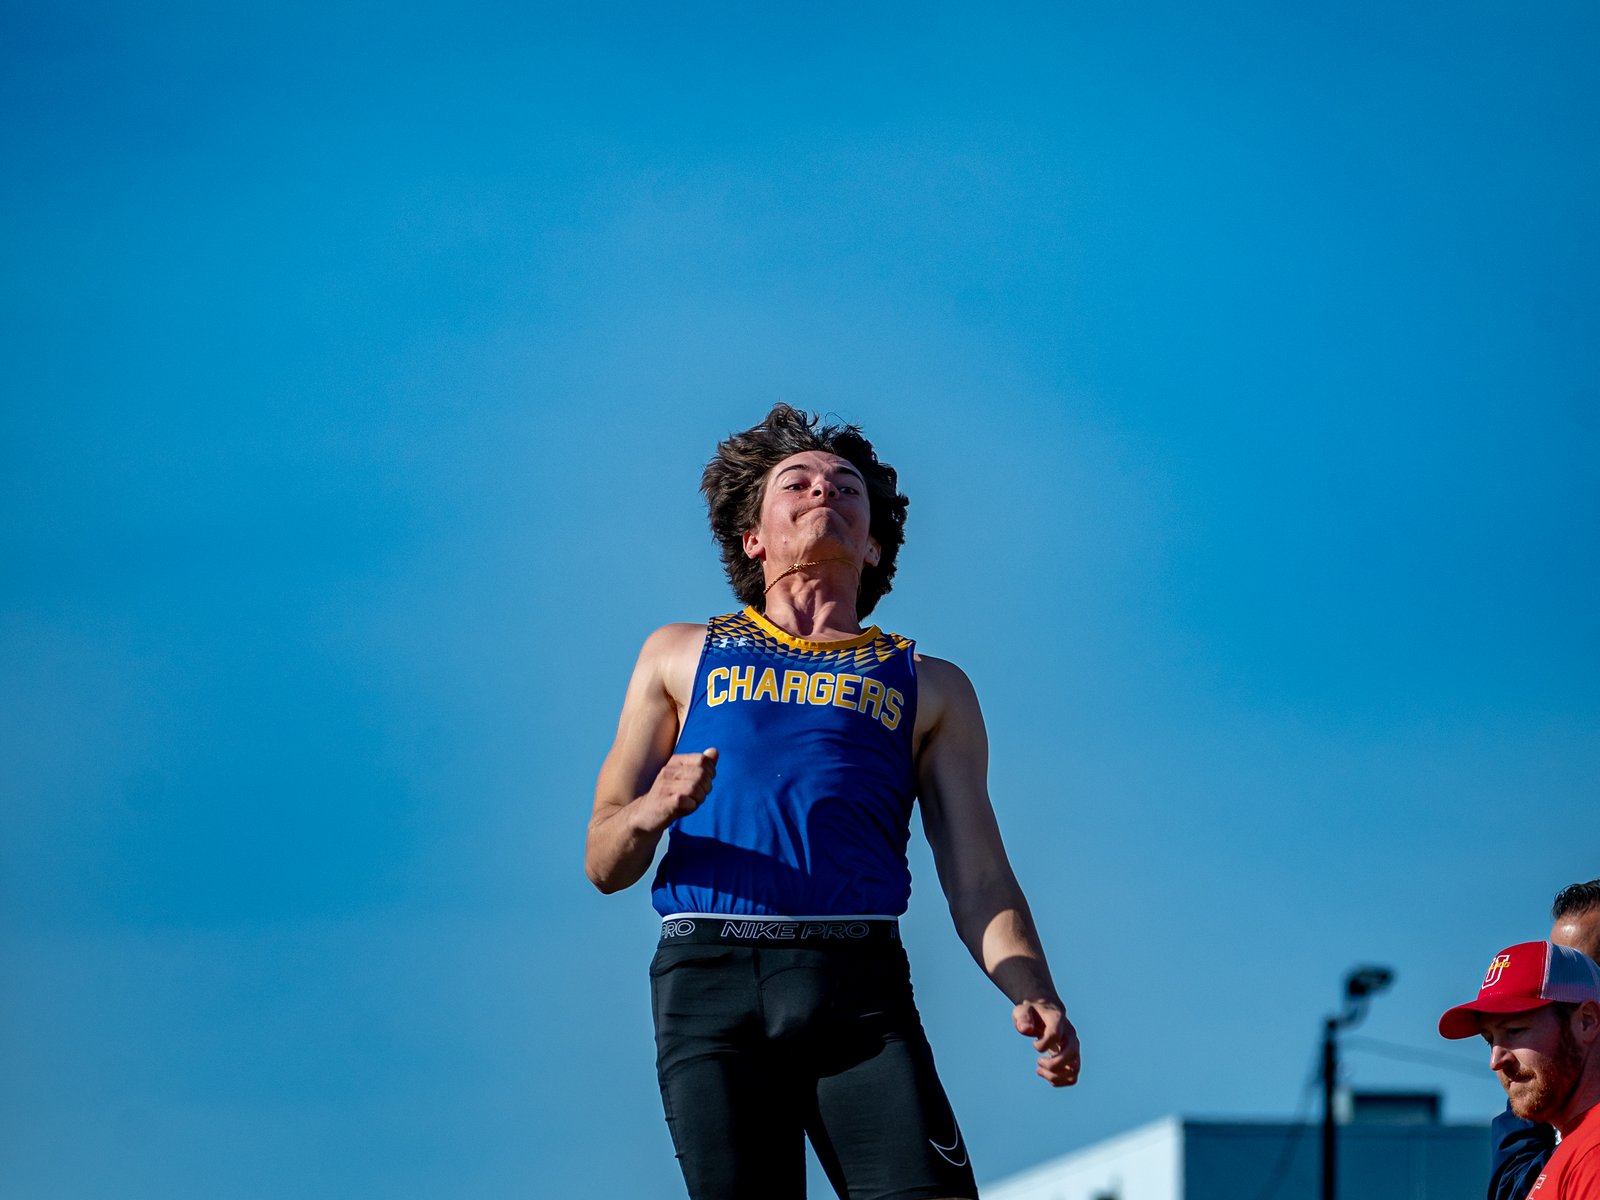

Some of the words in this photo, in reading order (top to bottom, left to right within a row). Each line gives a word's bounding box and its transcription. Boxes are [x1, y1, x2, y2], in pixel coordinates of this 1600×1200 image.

[707, 666, 904, 731] CHARGERS
[720, 921, 799, 940] NIKE
[801, 922, 869, 940] PRO
